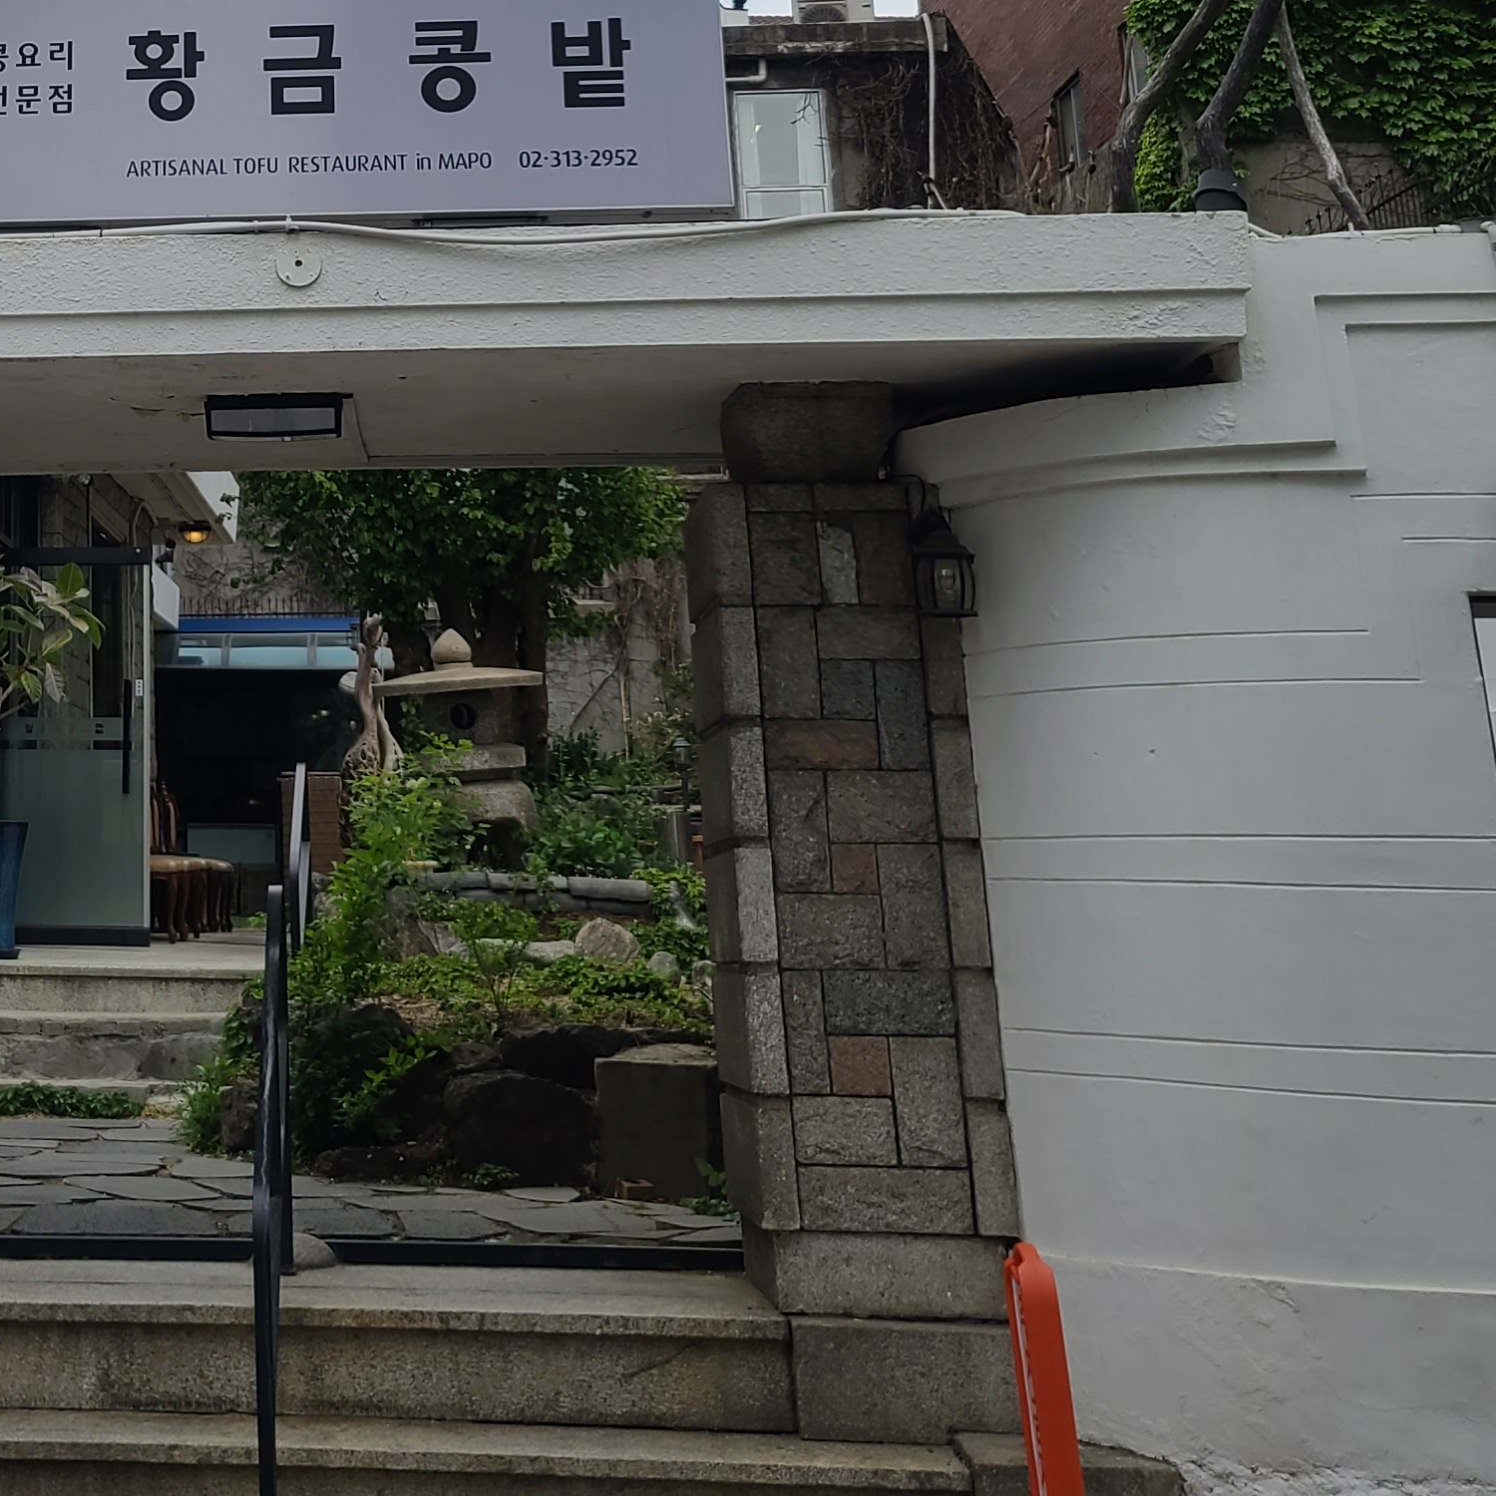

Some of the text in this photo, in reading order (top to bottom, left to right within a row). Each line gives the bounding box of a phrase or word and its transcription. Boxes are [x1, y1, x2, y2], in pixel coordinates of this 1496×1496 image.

[125, 17, 632, 122] 황금콩밭
[126, 159, 228, 177] ARTISANAL
[233, 157, 279, 175] TOFU
[288, 154, 408, 174] RESTAURANT
[416, 152, 432, 171] in
[438, 152, 493, 171] MAPO
